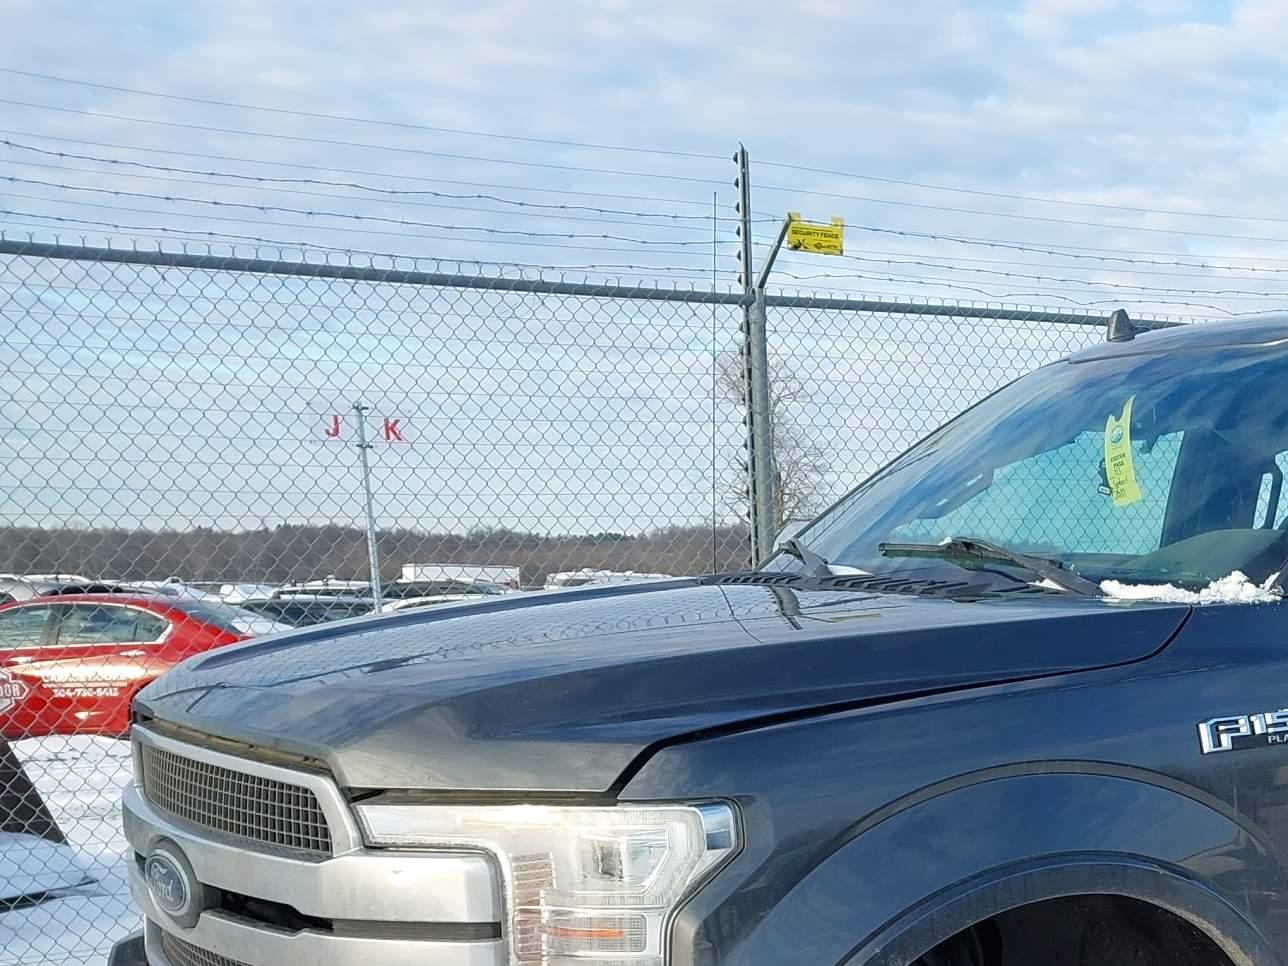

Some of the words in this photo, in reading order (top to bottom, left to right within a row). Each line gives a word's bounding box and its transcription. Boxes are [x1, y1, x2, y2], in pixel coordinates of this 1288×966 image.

[791, 229, 820, 238] SECURITY
[324, 414, 340, 437] J
[383, 417, 403, 441] K
